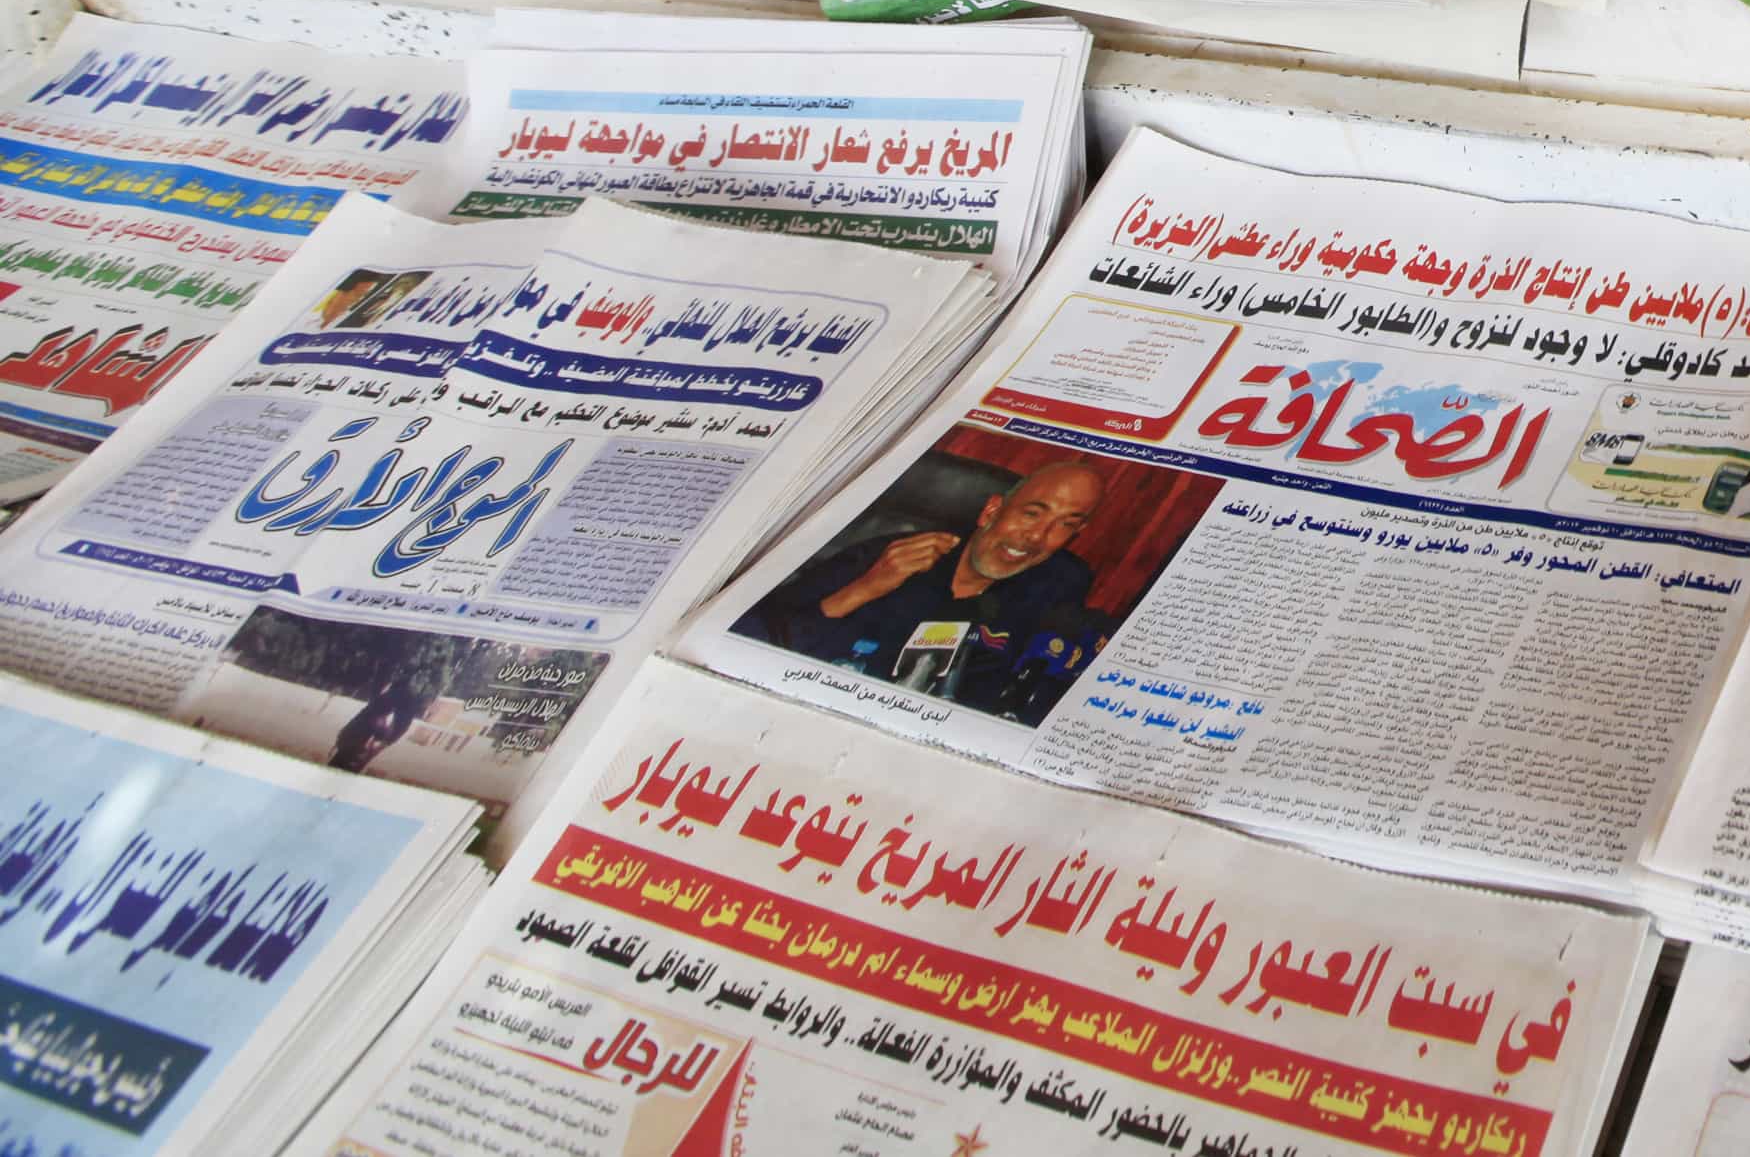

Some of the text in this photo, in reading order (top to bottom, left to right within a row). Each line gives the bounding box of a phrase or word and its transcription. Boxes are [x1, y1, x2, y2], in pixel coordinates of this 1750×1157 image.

[498, 116, 1012, 179] المريخ يرفع شعار الانتصار في مواجهة ليوبار
[957, 184, 999, 210] كتيبة
[1112, 192, 1225, 263] (الجزيرة)
[1207, 222, 1271, 262] عطش
[1266, 226, 1317, 272] وراء
[1317, 230, 1398, 280] حكومية
[1090, 255, 1191, 298] الشائعات
[1402, 243, 1467, 297] وجهة
[1468, 255, 1530, 300] الذرة
[1524, 256, 1593, 311] إنتاج
[1585, 266, 1631, 314] طن
[1188, 275, 1237, 313] وراء
[1237, 282, 1346, 324] الخامس)
[1628, 282, 1706, 327] ملايين
[1449, 312, 1524, 353] لنزوح
[1523, 327, 1588, 367] وجود
[1595, 332, 1619, 365] لا
[1222, 500, 1271, 524] زراعته
[1272, 508, 1299, 530] في
[1298, 514, 1374, 543] وسنتوسع
[1377, 530, 1413, 551] يورو
[1415, 534, 1470, 555] ملايين
[1504, 548, 1534, 569] وفر
[1536, 554, 1596, 578] المحور
[1600, 562, 1654, 586] القطن
[784, 666, 820, 683] العربي
[821, 674, 858, 695] الصمت
[1096, 668, 1138, 689] مرض
[1139, 677, 1188, 701] شائعات
[857, 690, 876, 701] من
[878, 693, 923, 715] استغرابه
[1179, 718, 1204, 734] لن
[1200, 721, 1245, 742] البشير
[601, 736, 761, 840] ليوبار
[738, 785, 869, 884] يتوعد
[856, 812, 1027, 912] المريخ
[1103, 873, 1229, 999] وليلة
[552, 843, 1440, 1150] يجهز كتيبة الملاعب يهز ارض وسماء ام درمان بحثا عن الذهب الافريقي
[1218, 936, 1392, 1023] العبور
[514, 907, 1192, 1152] بالحضور المكثف والمؤازرة والروابط القوافل لقلعة الصمود
[1387, 963, 1496, 1059] سبت
[581, 1016, 721, 1100] للرجال
[1495, 978, 1578, 1097] في
